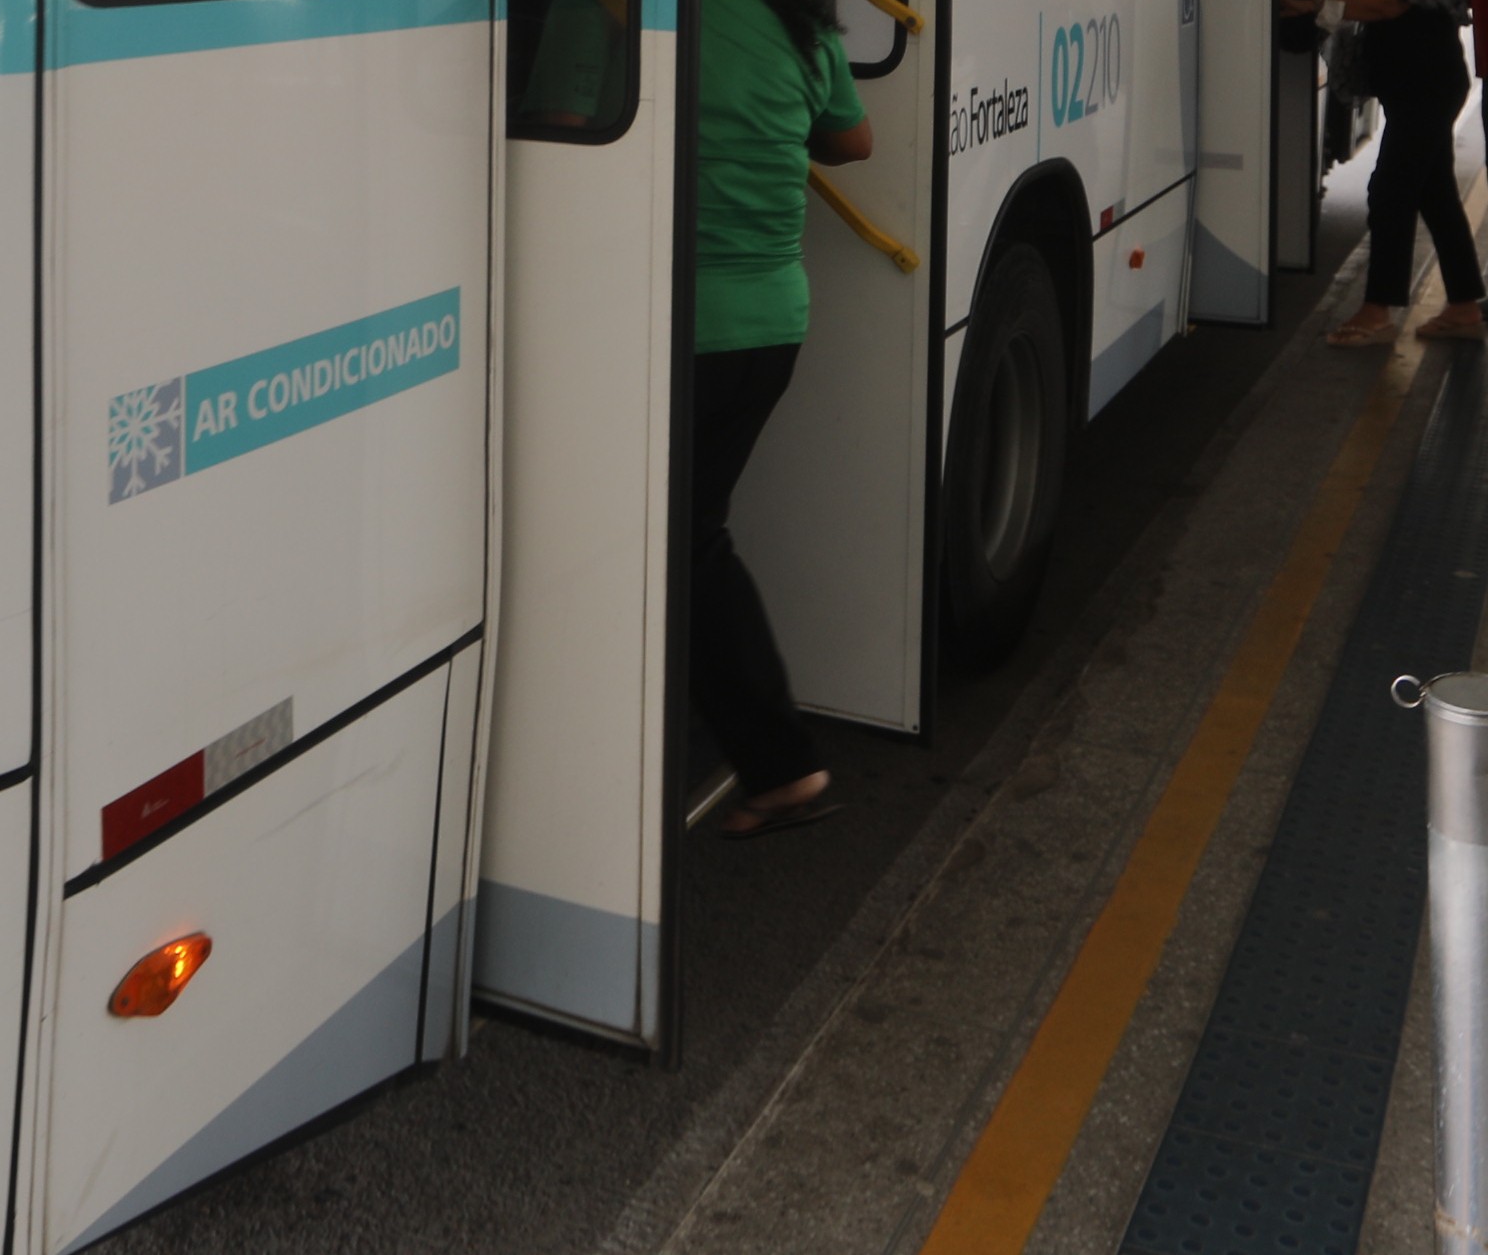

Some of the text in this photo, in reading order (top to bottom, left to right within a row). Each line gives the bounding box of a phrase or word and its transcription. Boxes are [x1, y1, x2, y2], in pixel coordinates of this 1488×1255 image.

[949, 77, 1029, 156] ão Fortaleza
[1051, 12, 1121, 128] 02210
[192, 314, 457, 443] AR CONDICIONADO
